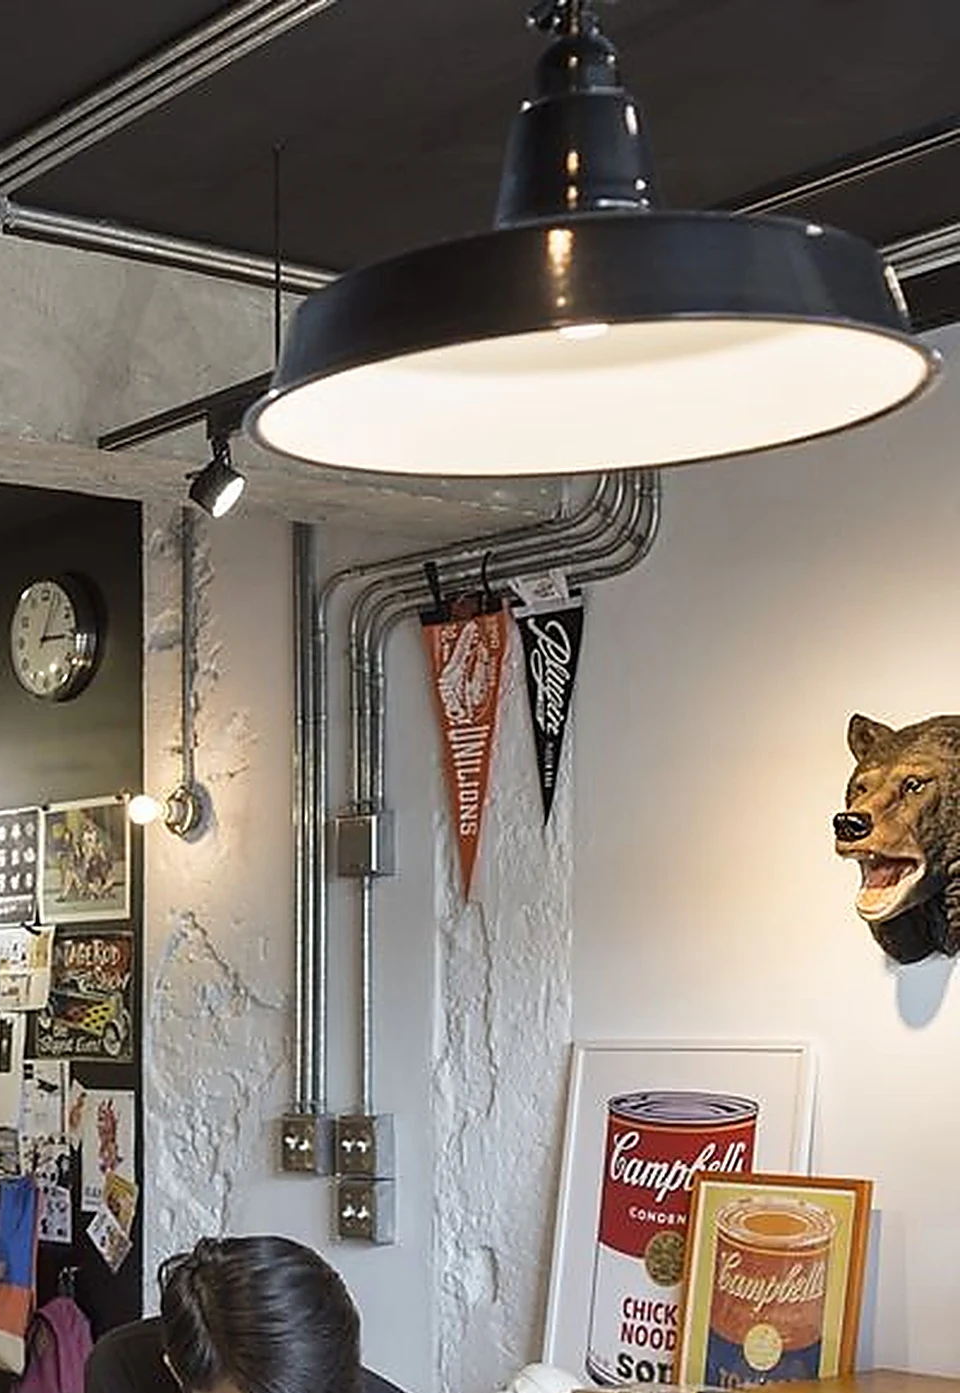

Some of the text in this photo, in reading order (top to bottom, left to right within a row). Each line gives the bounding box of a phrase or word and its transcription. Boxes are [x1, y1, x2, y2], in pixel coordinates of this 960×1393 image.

[628, 1205, 688, 1225] CONDEN
[622, 1296, 679, 1326] CHICK
[620, 1321, 678, 1352] NOOD
[615, 1352, 674, 1384] SO
